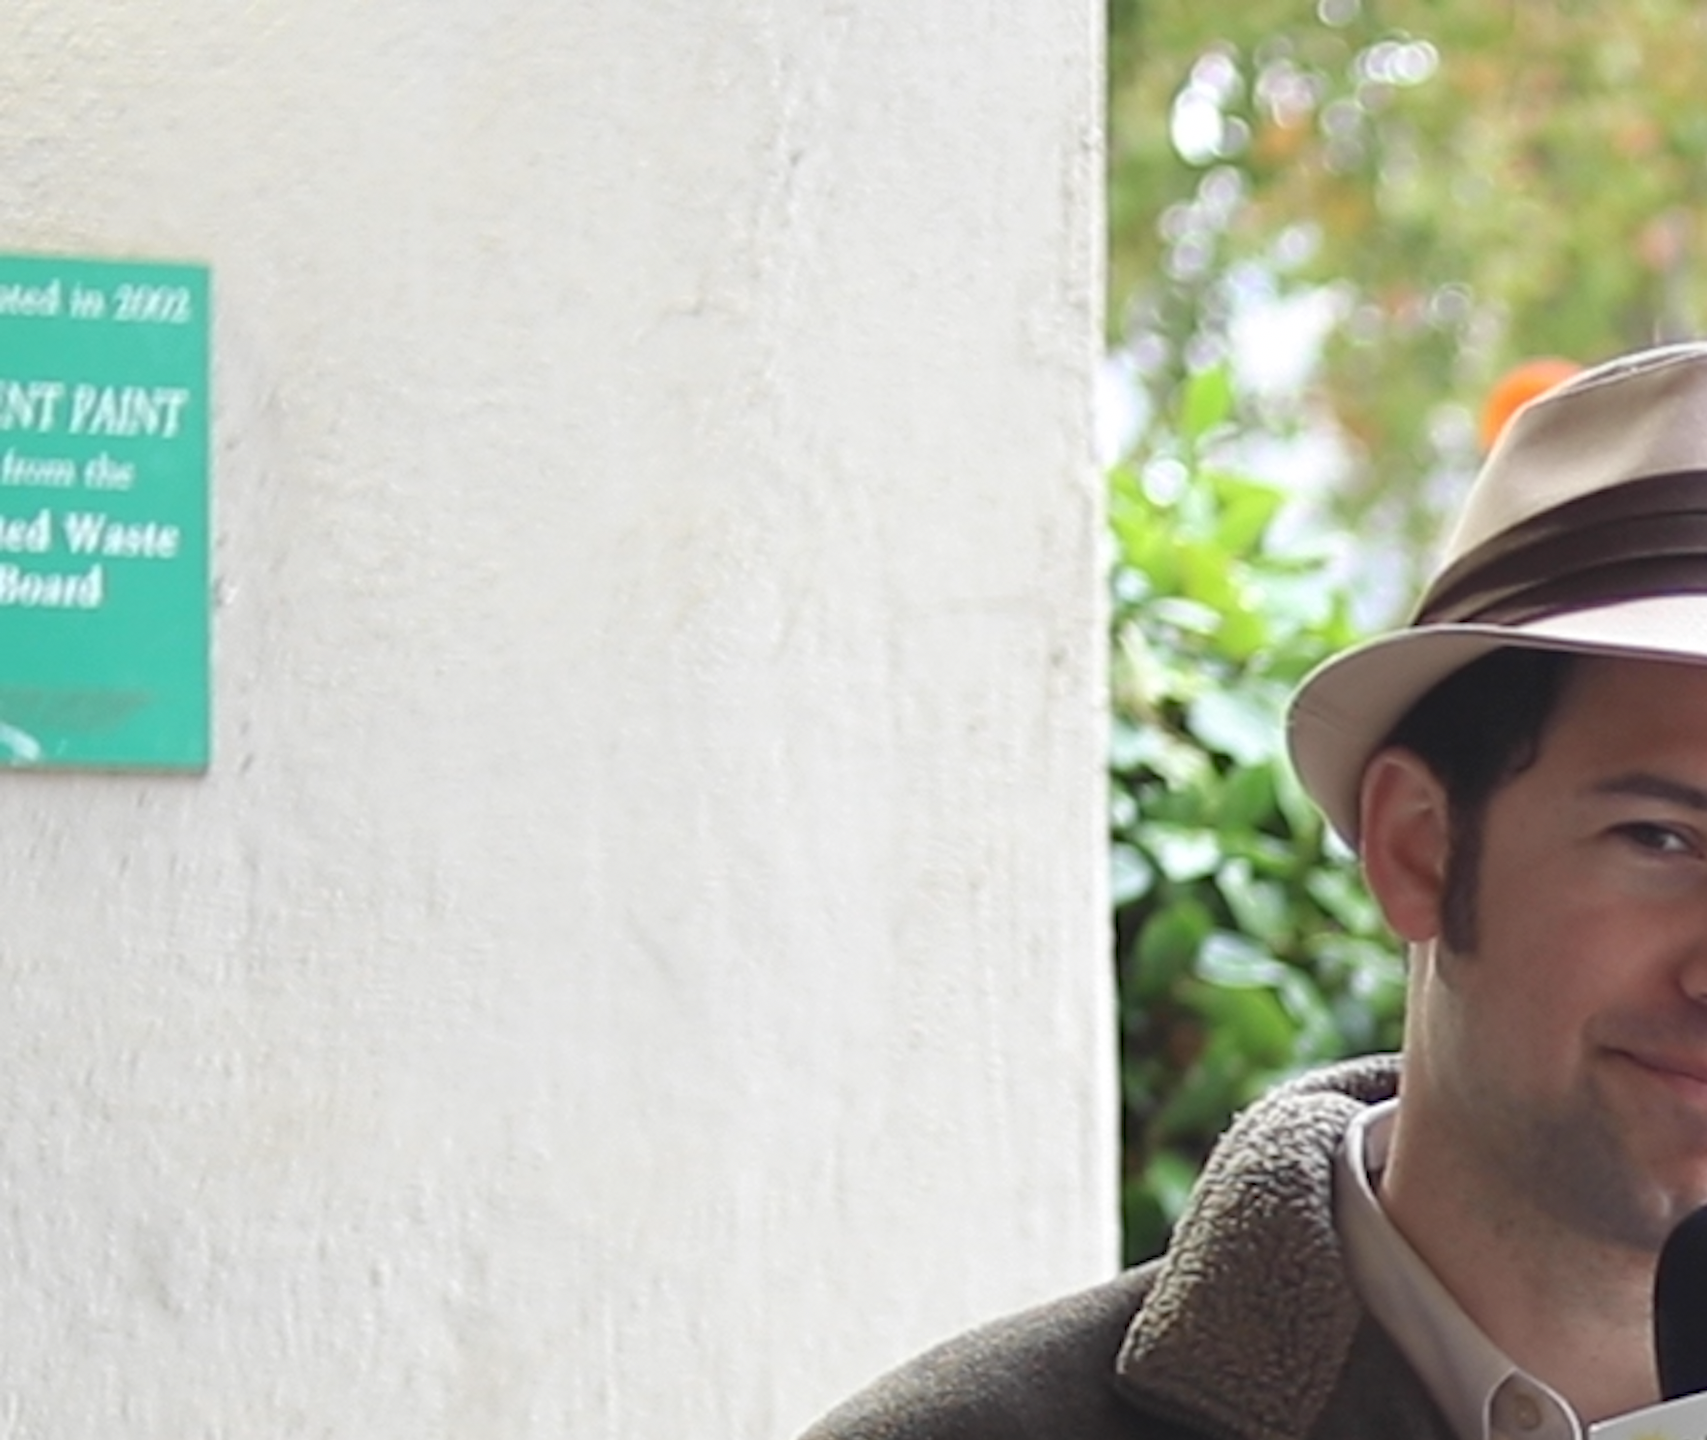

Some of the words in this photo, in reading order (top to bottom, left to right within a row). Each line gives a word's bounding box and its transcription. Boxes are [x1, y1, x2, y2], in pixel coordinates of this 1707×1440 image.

[70, 281, 105, 320] in
[113, 283, 190, 324] 2002
[0, 380, 64, 432] NT
[69, 383, 189, 438] PAINT
[1, 447, 75, 486] from
[84, 450, 136, 491] the
[63, 512, 180, 559] Waste
[0, 563, 102, 607] Board
